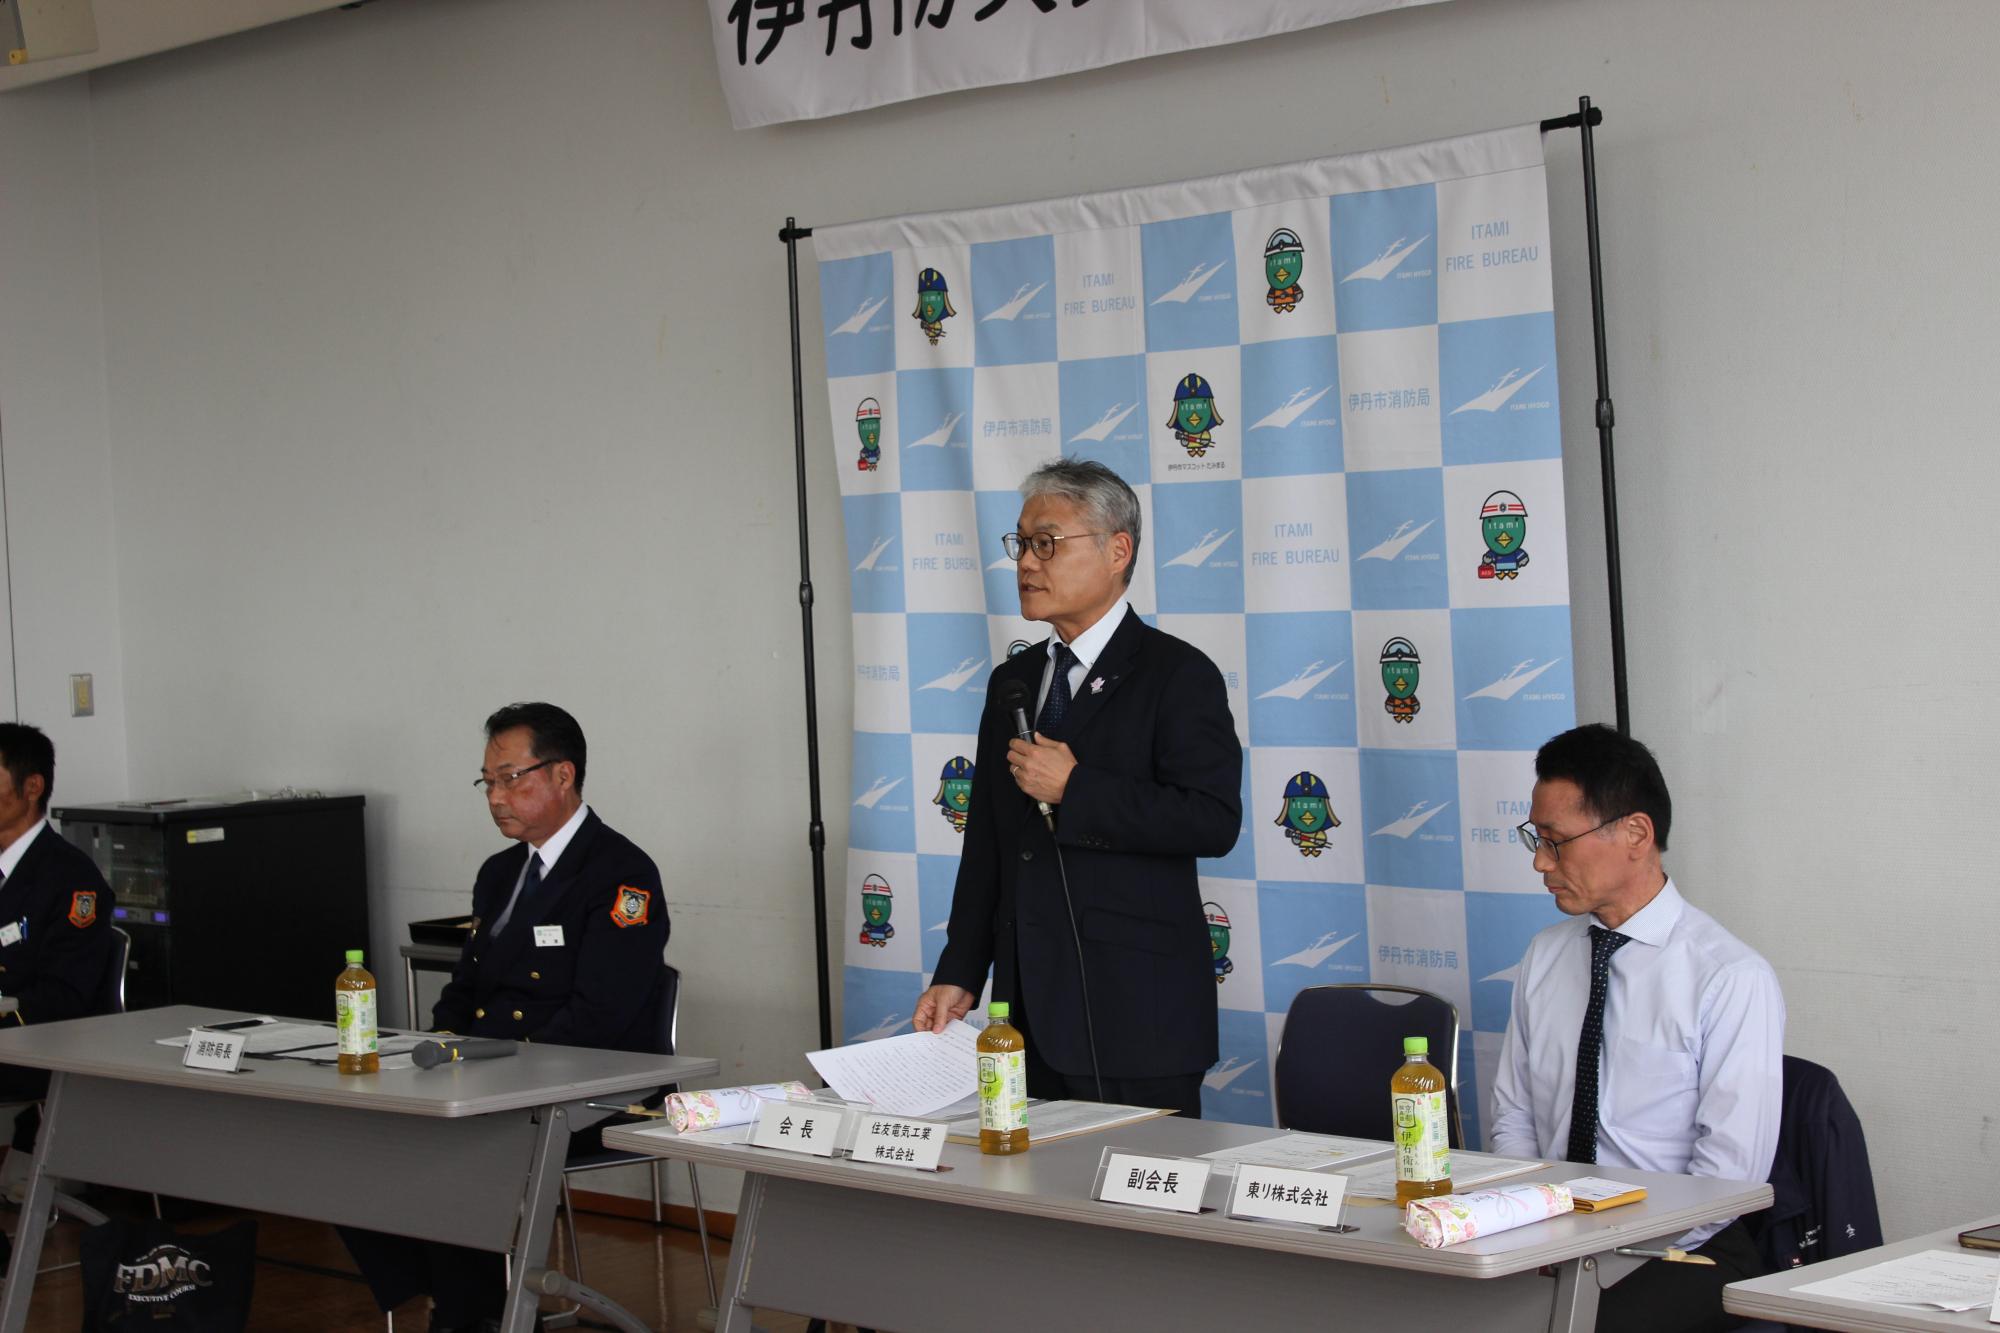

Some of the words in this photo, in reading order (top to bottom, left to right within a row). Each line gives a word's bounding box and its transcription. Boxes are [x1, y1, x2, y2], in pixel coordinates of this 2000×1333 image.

[1471, 220, 1509, 240] ITAMI
[1445, 254, 1474, 273] FIRE
[1482, 246, 1539, 267] BUREAU
[1082, 272, 1115, 289] ITAMI
[1063, 302, 1086, 316] FIRE
[1092, 296, 1136, 313] BUREAU
[1181, 402, 1207, 411] itami
[1348, 387, 1431, 412] 伊丹市消防局
[983, 418, 1052, 438] 伊丹市消防局
[1274, 523, 1313, 538] ITAMI
[1488, 521, 1518, 530] itami
[935, 532, 964, 546] ITAMI
[912, 557, 937, 571] FIRE
[1252, 551, 1278, 566] FIRE
[1286, 548, 1341, 565] BUREAU
[1292, 801, 1322, 809] itami
[1496, 800, 1531, 815] ITAM
[1471, 828, 1500, 843] FIRE
[1378, 945, 1459, 970] 伊丹市消防局
[871, 1121, 932, 1141] 住友電気工業
[875, 1144, 915, 1162] 株式会社
[1127, 1168, 1180, 1194] 副会長
[113, 1256, 213, 1293] FDMC
